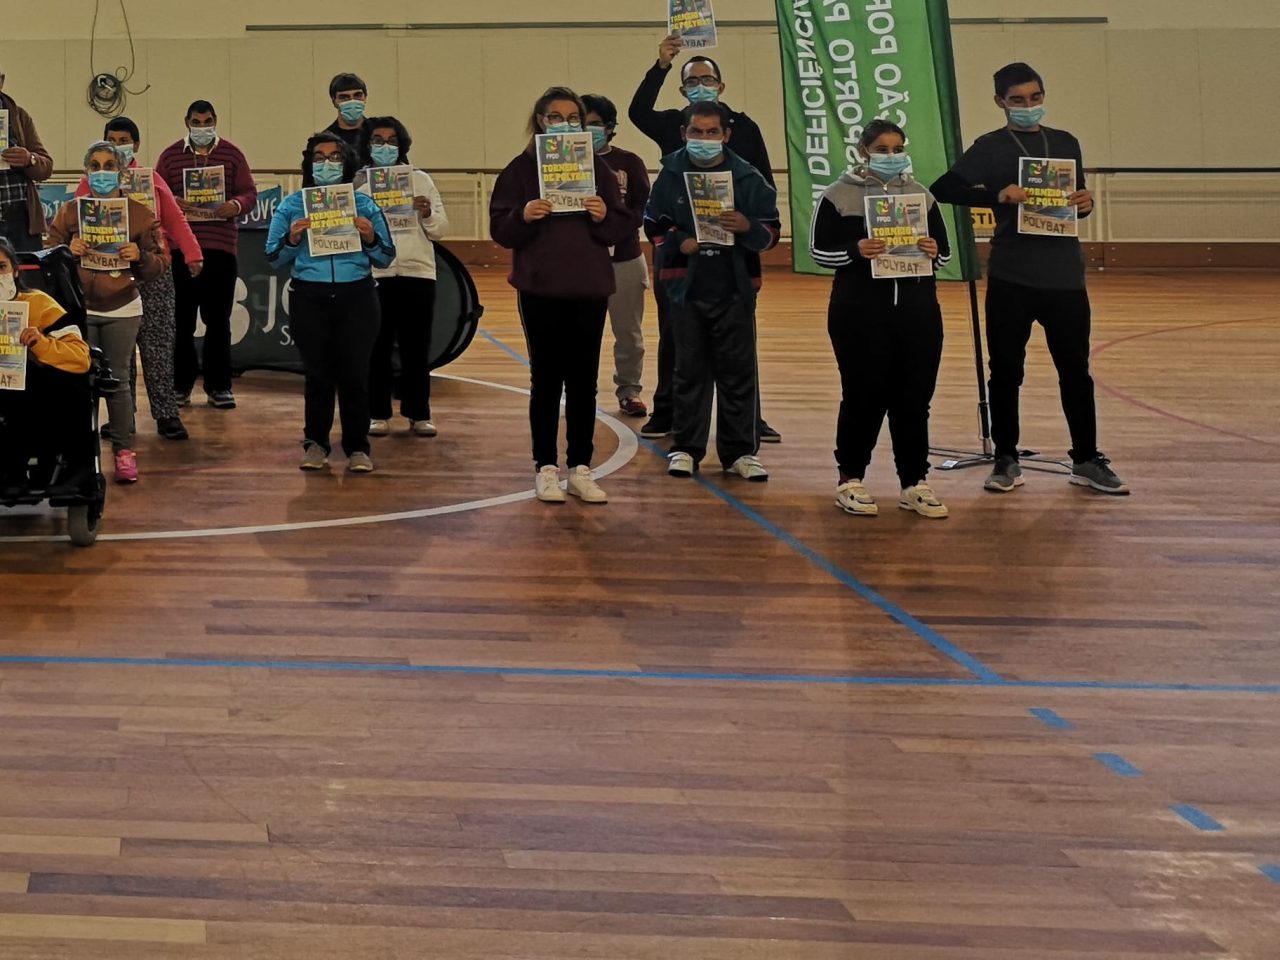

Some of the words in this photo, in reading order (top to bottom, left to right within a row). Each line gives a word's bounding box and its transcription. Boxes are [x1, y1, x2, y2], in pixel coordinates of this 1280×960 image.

[542, 162, 578, 173] TORNEIO
[543, 173, 557, 182] DE
[558, 171, 592, 181] POLYBAT
[1023, 187, 1061, 197] TORNEIO
[1037, 197, 1068, 207] POLYBA
[321, 216, 354, 227] POLYBAT
[1023, 216, 1066, 234] POLYBAT
[873, 226, 912, 237] TORNEIO
[94, 234, 125, 243] POLYBAT
[313, 239, 349, 250] POLYBAT
[877, 259, 919, 275] POLYBAT
